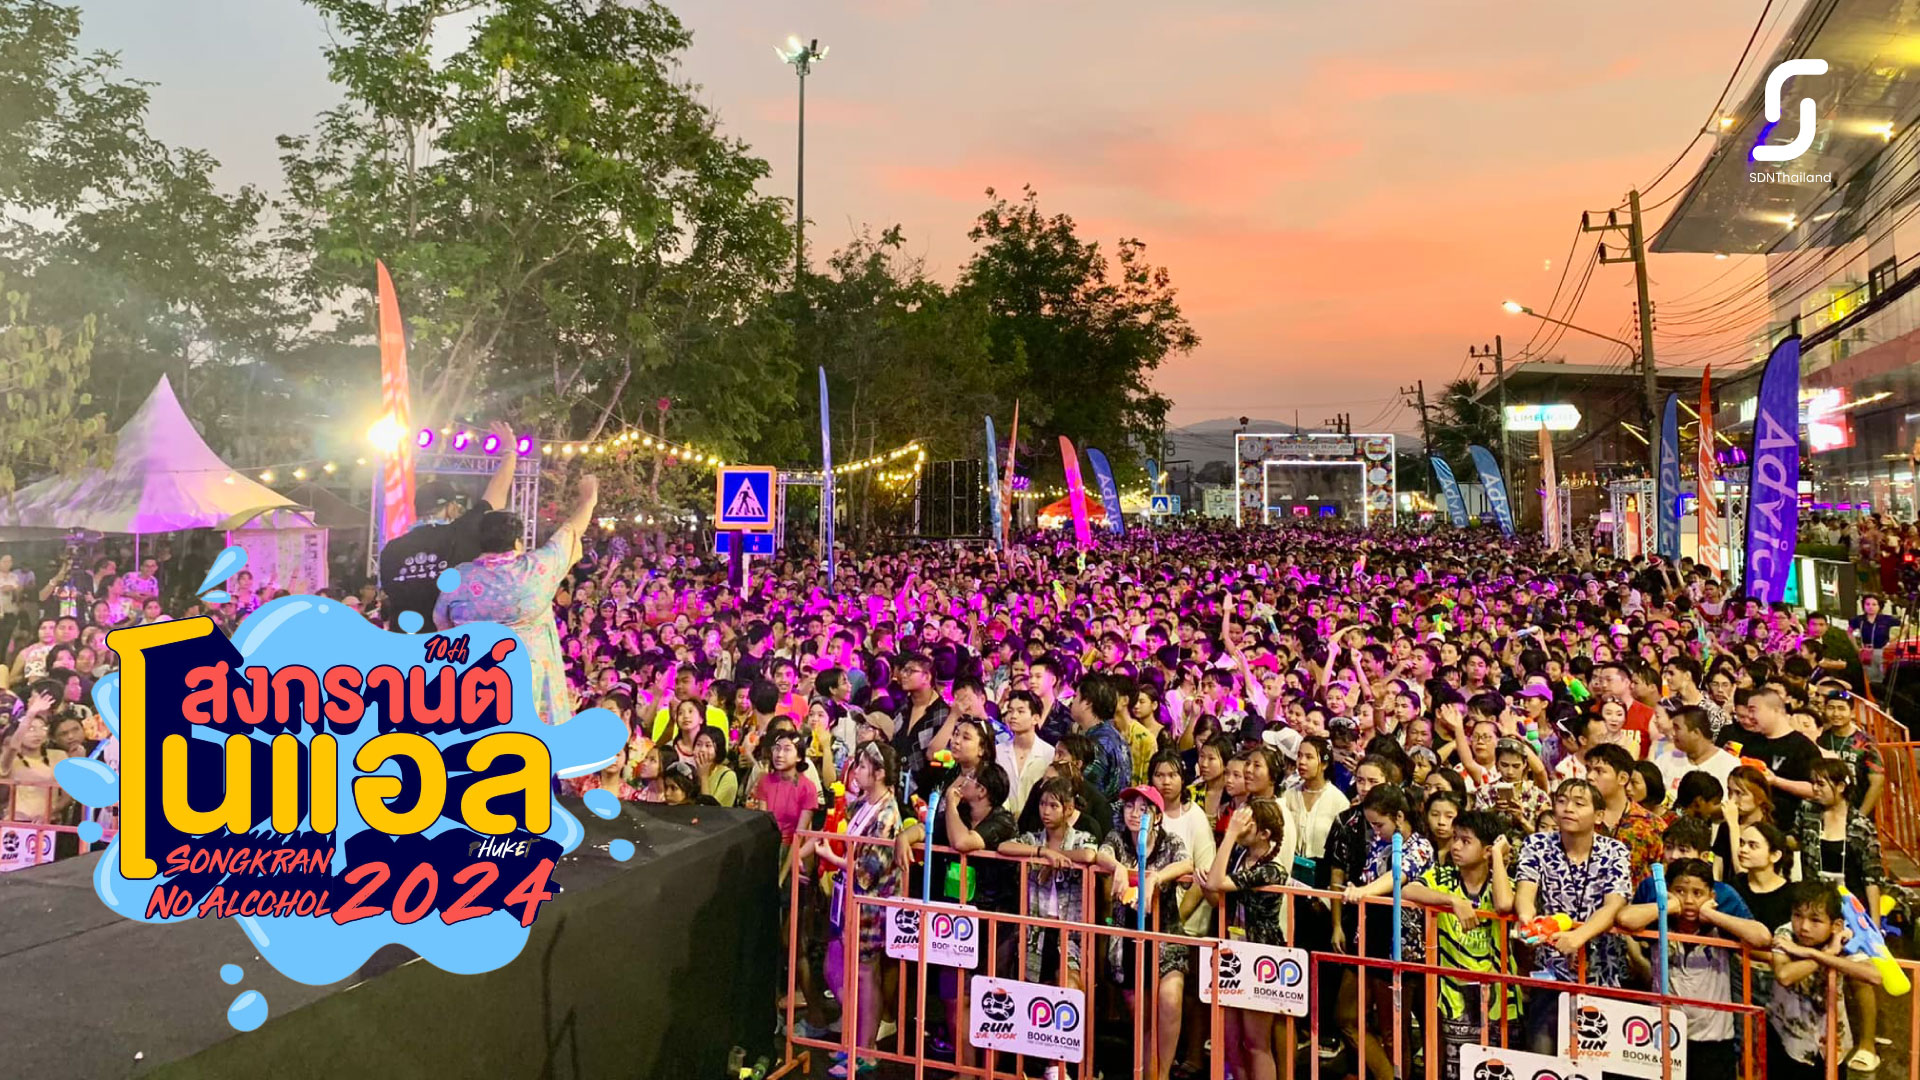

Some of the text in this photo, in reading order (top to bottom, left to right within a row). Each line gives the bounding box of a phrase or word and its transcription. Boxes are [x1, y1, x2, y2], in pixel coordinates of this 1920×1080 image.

[1439, 477, 1466, 529] Advic
[1662, 438, 1680, 556] Advic
[974, 1031, 1017, 1041] SAOOK
[979, 1022, 1014, 1033] RUN
